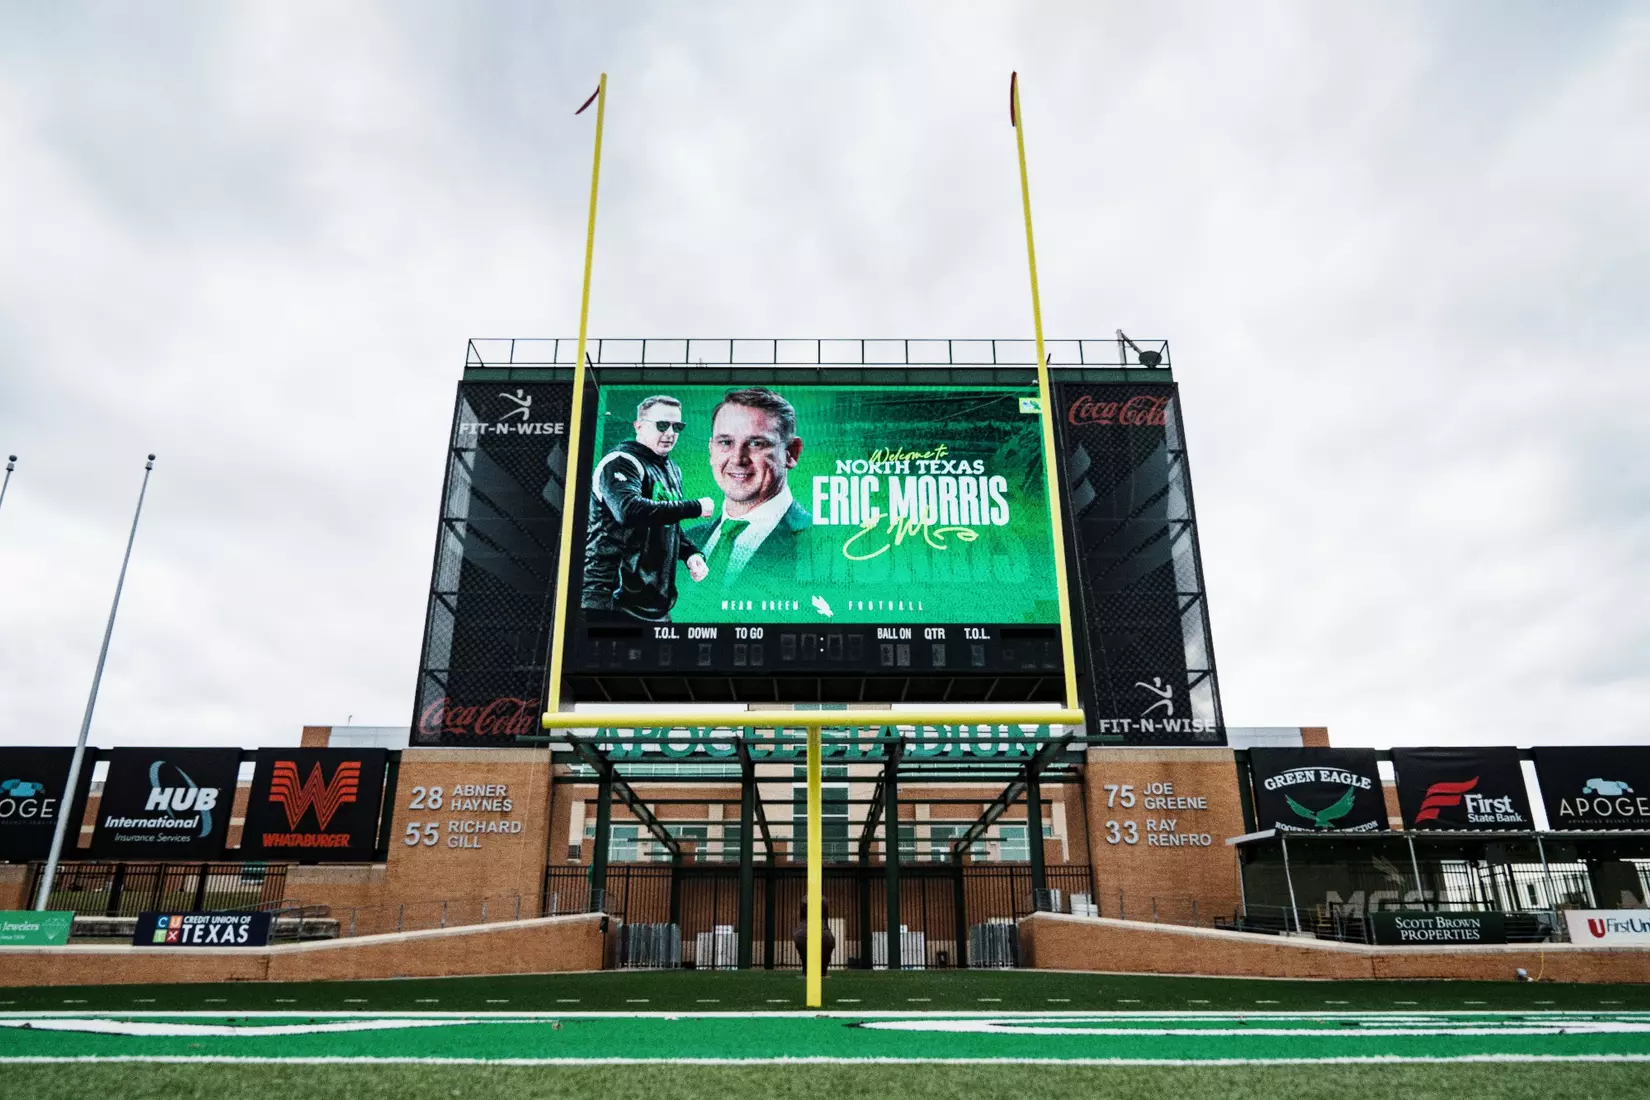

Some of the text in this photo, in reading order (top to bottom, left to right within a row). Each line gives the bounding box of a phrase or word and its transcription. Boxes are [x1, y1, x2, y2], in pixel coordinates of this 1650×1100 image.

[459, 423, 564, 435] FIT-N-WISE
[869, 443, 949, 465] Welcome to
[836, 459, 985, 474] NORTH TEXAS
[812, 475, 1010, 526] ERIC MORRIS
[848, 600, 923, 611] FOOTBALL
[654, 627, 680, 639] T.O.L.
[688, 627, 717, 639] DOWN
[735, 627, 764, 639] TO GO
[877, 627, 912, 639] BALL ON
[924, 627, 946, 639] QTR
[964, 627, 991, 639] T.O.L.
[1100, 719, 1216, 733] FIT-N-WISE
[1264, 770, 1371, 790] GREEN EAGLE
[452, 784, 507, 796] ABNER
[1144, 783, 1173, 795] JOE
[145, 787, 219, 811] HUB
[409, 786, 444, 810] 28
[1104, 784, 1136, 808] 75
[450, 799, 513, 812] HAYNES
[1144, 797, 1208, 810] GREENE
[1464, 793, 1515, 813] First
[104, 815, 200, 828] International
[1468, 813, 1523, 823] State Bank
[448, 821, 521, 833] RICHARD
[1147, 819, 1177, 831] RAY
[114, 832, 191, 842] Insurance Services
[404, 822, 440, 846] 55
[1105, 820, 1139, 844] 33
[263, 833, 351, 847] WHATABURGER
[448, 835, 482, 848] GILL
[1147, 833, 1212, 846] RENFRO
[183, 915, 252, 924] CREDIT UNION OF
[1395, 916, 1481, 929] SCOTT BROWN
[182, 924, 250, 943] TEXAS
[1401, 929, 1480, 940] PROPERTIES
